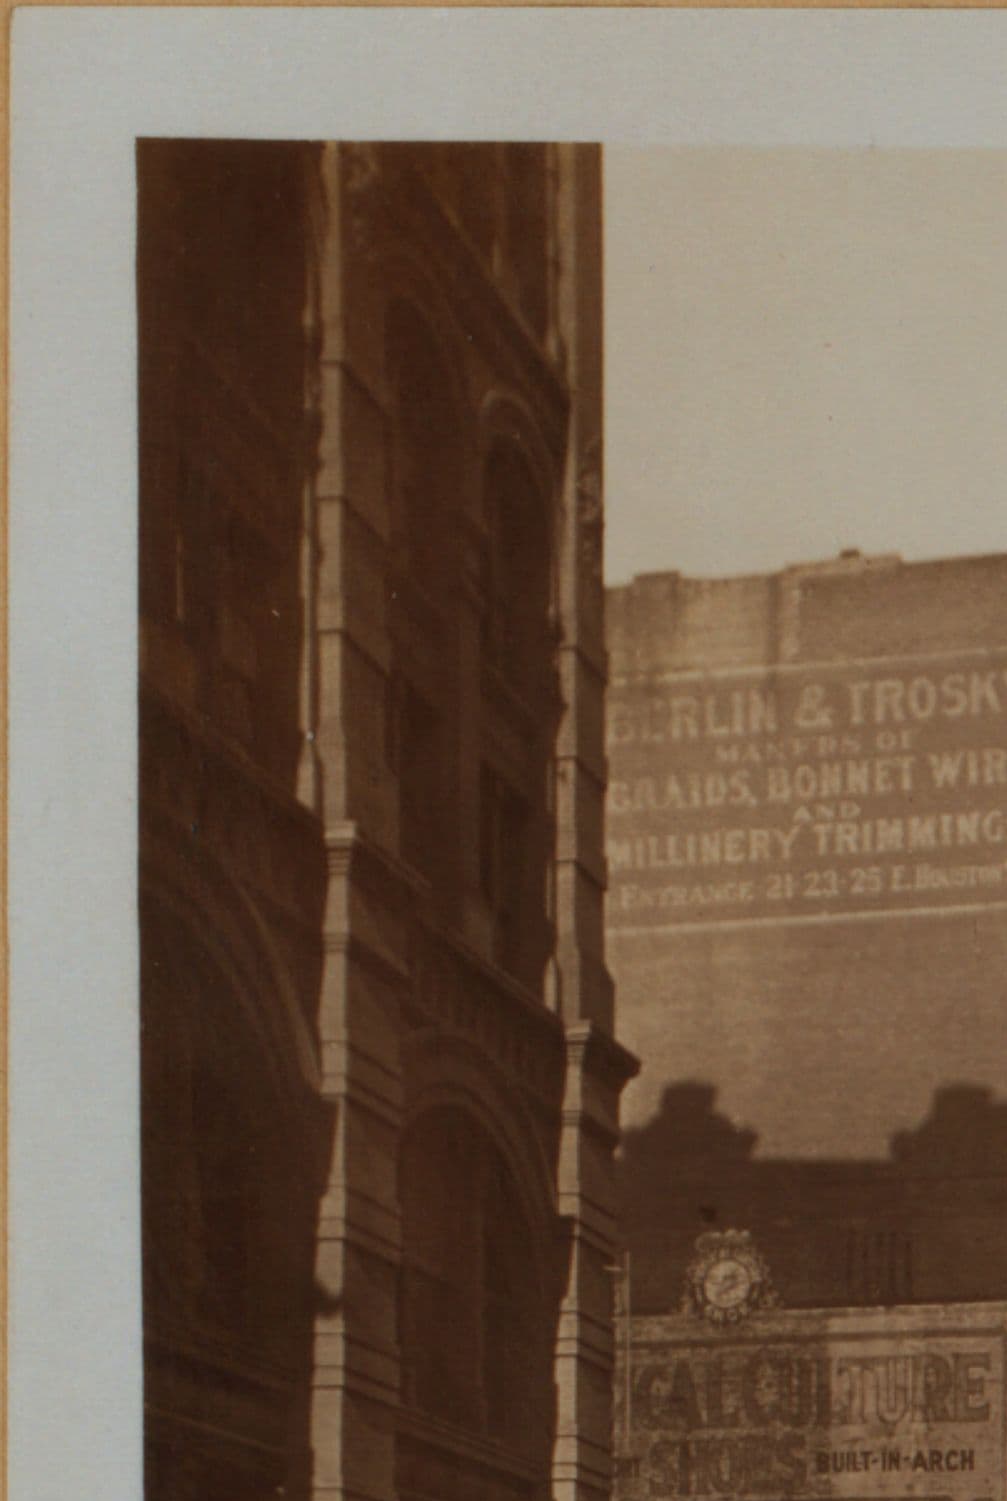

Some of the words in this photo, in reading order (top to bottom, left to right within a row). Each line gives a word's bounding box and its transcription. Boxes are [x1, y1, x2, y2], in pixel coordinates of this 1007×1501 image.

[794, 685, 833, 728] &
[876, 730, 917, 751] OF
[766, 755, 917, 803] BONNET
[792, 800, 861, 823] AND
[607, 828, 801, 870] MILLINERY
[815, 1449, 976, 1473] BUILT-IN-ARCH
